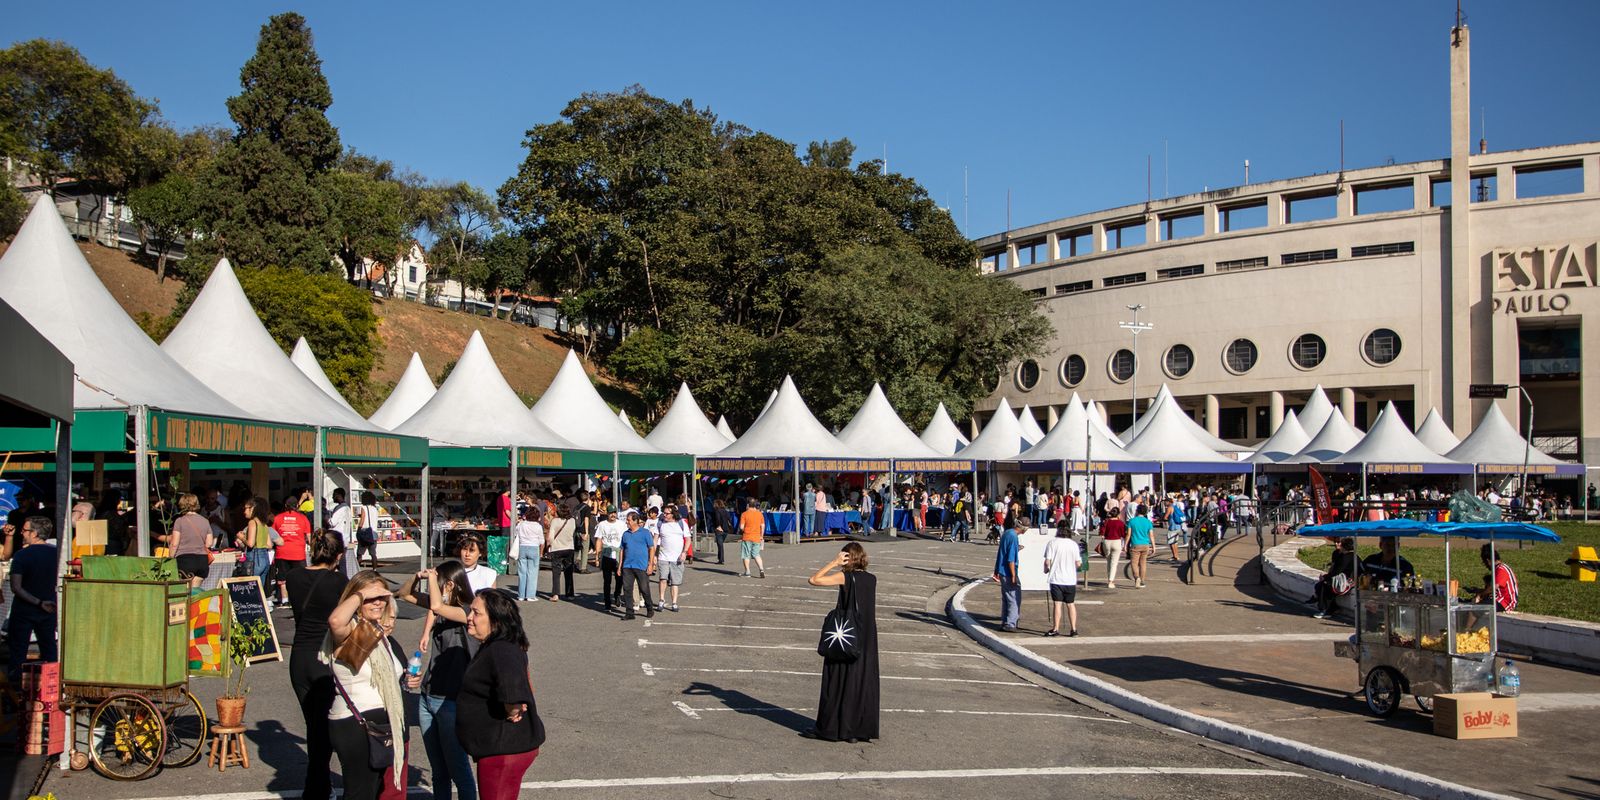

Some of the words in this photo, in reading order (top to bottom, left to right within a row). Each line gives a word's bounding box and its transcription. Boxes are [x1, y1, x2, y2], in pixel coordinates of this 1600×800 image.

[1493, 242, 1600, 292] ESTA
[189, 420, 212, 450] BAZAR
[222, 423, 242, 452] TEMPO
[1464, 711, 1492, 727] Boby
